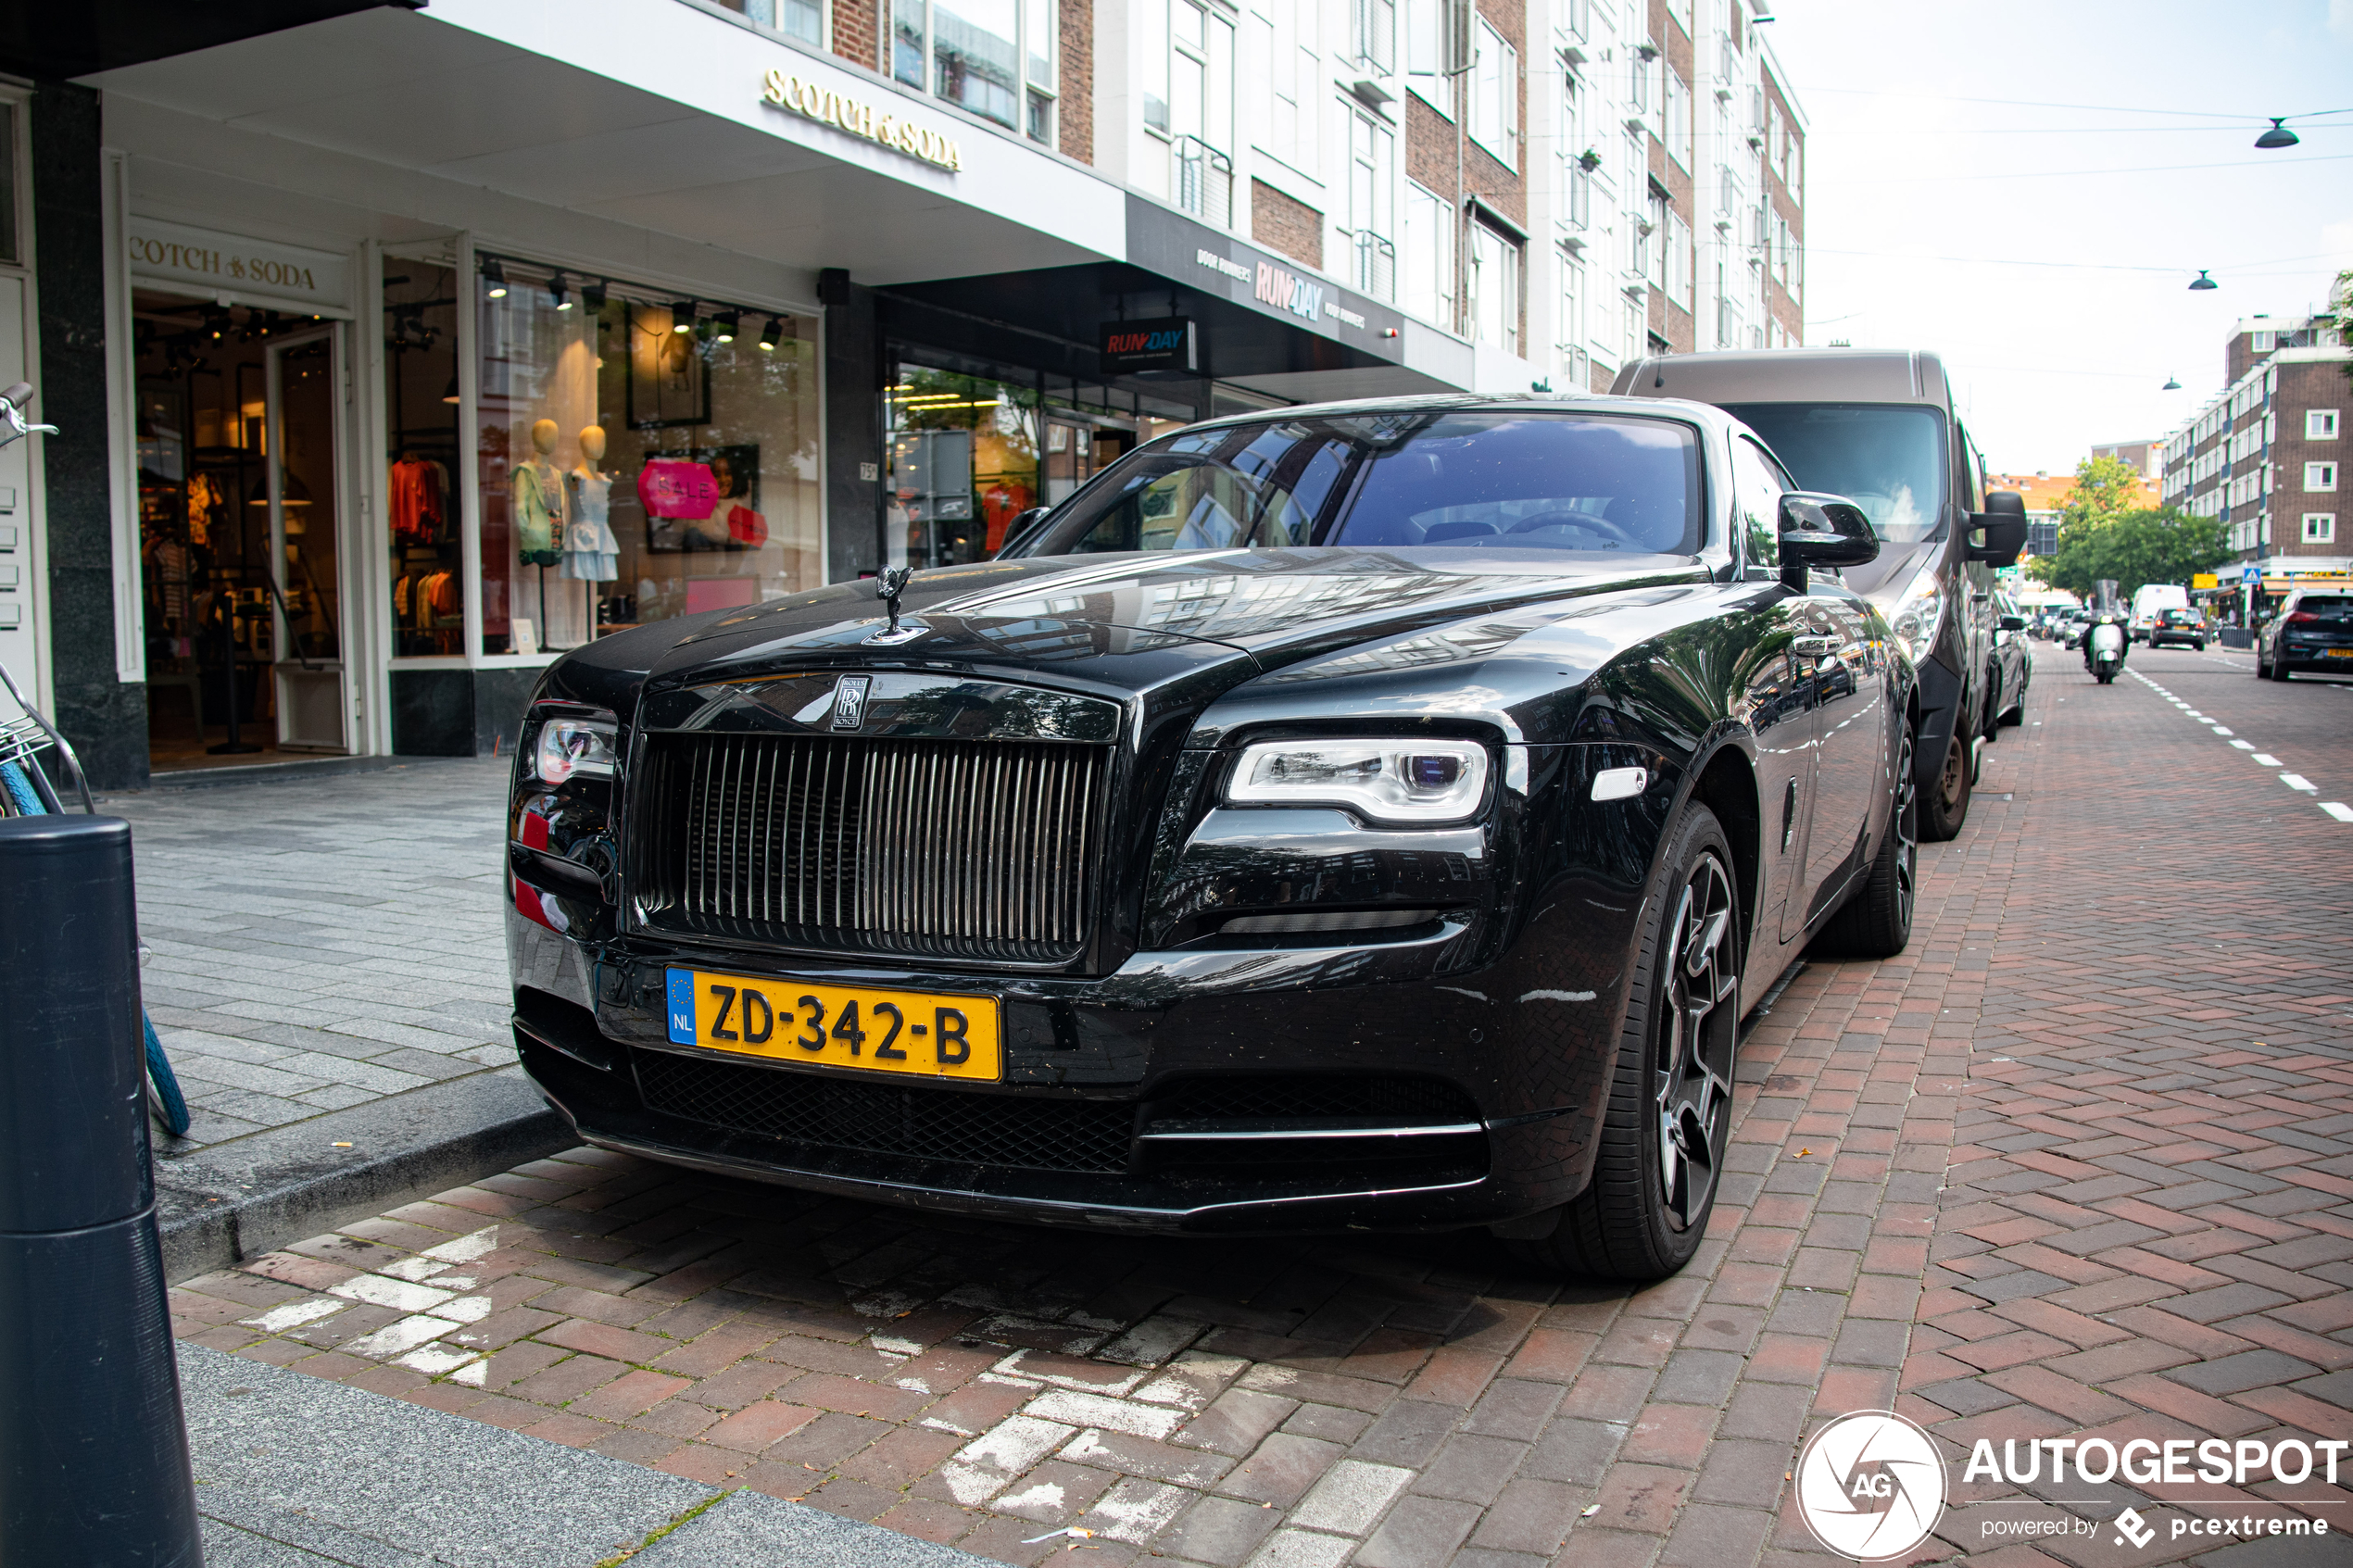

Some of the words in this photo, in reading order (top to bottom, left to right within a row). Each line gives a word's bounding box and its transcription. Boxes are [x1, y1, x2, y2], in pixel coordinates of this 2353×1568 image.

[764, 68, 875, 139] SCOTCH
[878, 114, 900, 147] &
[900, 120, 963, 171] SODA
[130, 236, 220, 274] COTCH
[226, 256, 245, 278] &
[249, 258, 316, 290] SODA
[1218, 257, 1251, 282] RUNNERS
[1340, 308, 1365, 330] RUNNERS
[658, 479, 710, 498] SALE
[674, 1013, 693, 1032] NL
[711, 985, 971, 1064] ZD-342-B
